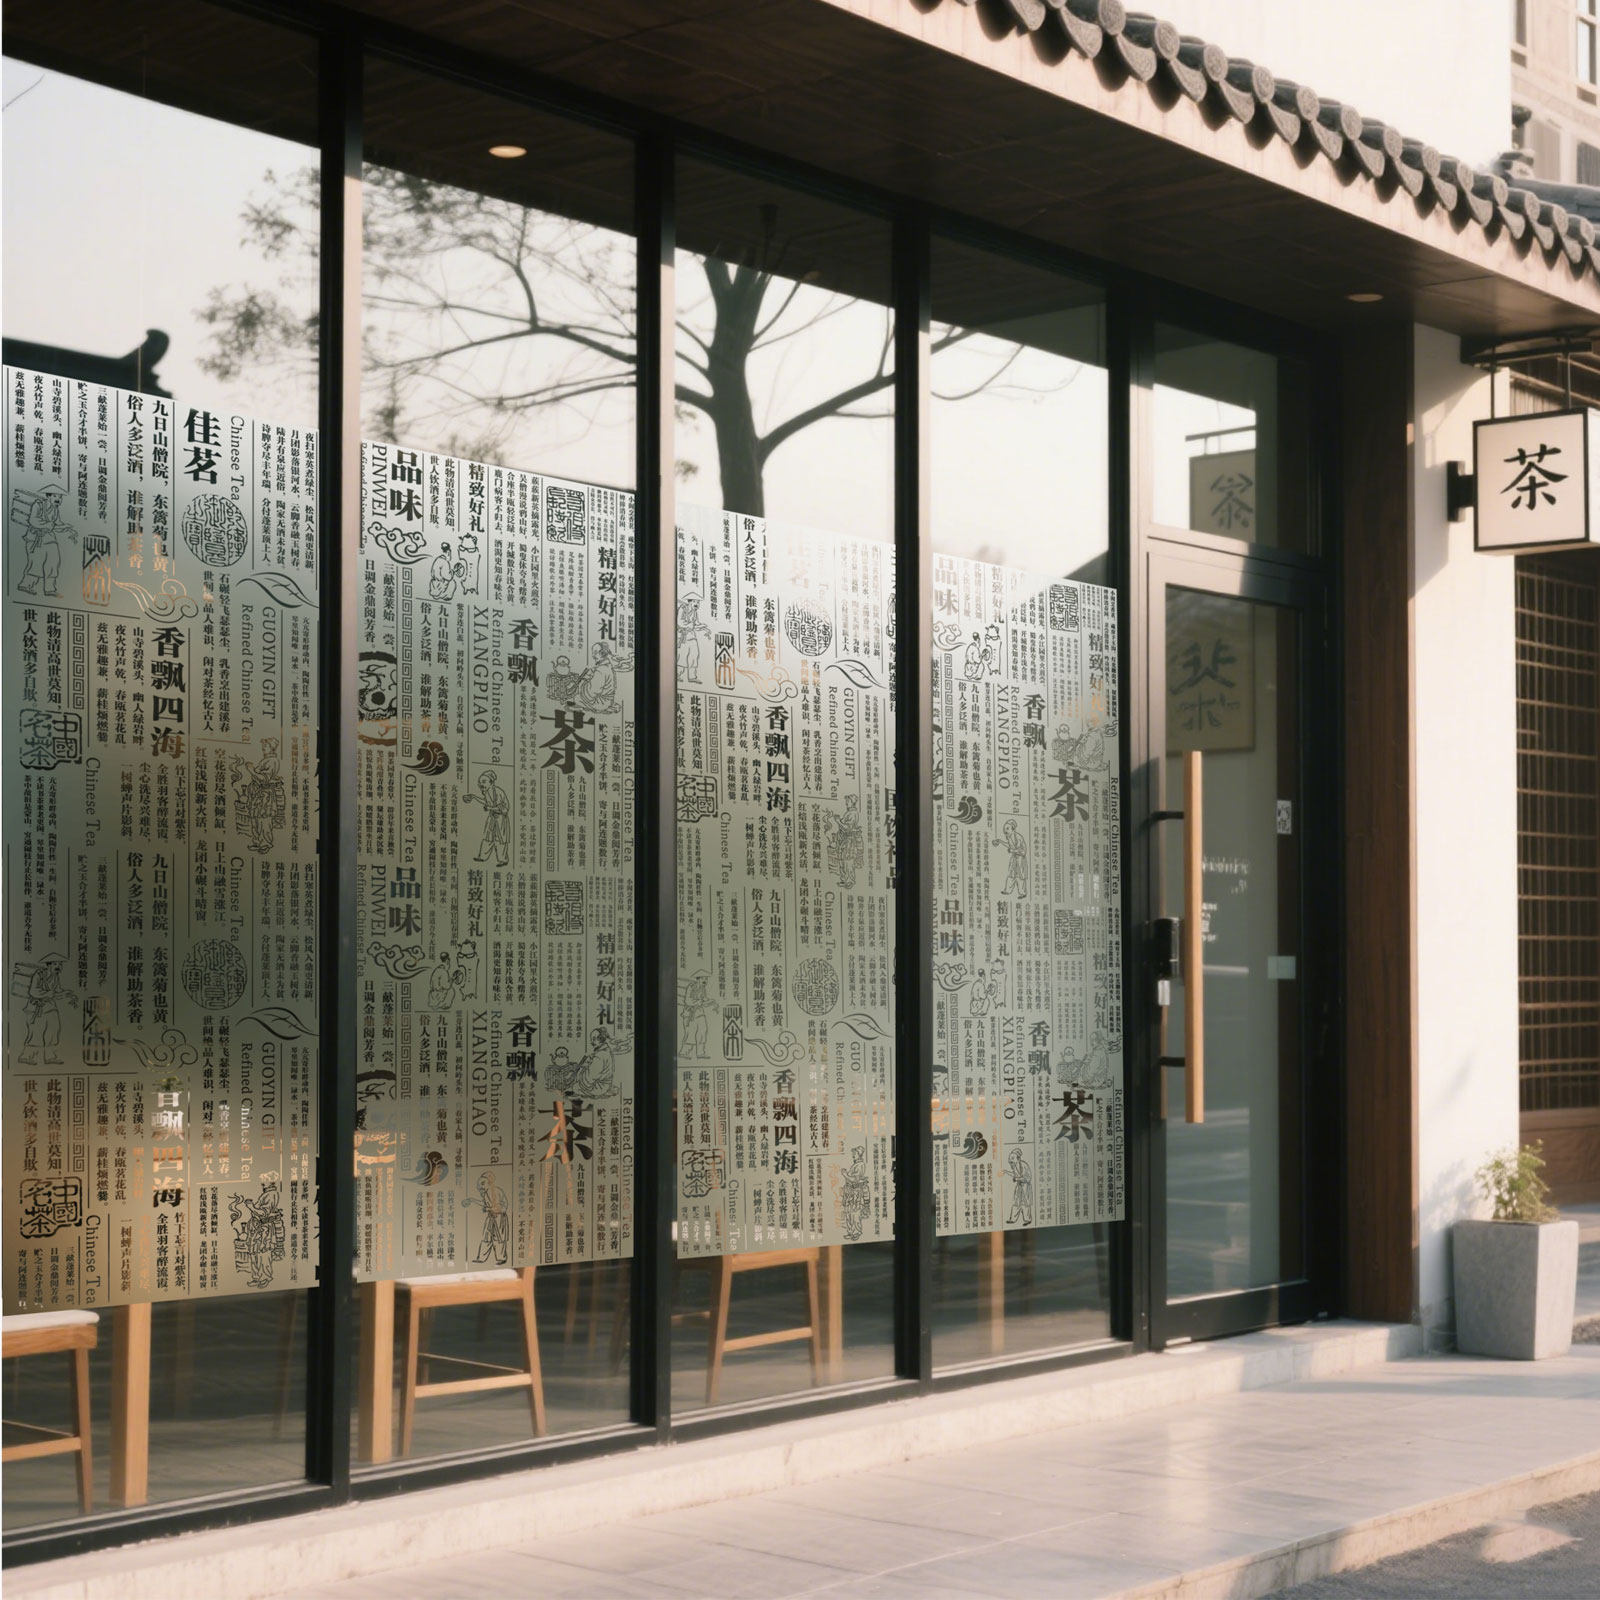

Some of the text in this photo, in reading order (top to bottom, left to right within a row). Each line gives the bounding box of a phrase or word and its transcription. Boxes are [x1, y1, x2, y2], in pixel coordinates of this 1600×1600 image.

[183, 408, 222, 485] 佳茗
[230, 415, 245, 501] Chinese Tea
[372, 443, 387, 519] PINWEI
[1500, 443, 1569, 511] 茶
[390, 450, 424, 522] 品味
[468, 463, 485, 533] 精致好礼
[597, 546, 617, 641] 精致好礼
[241, 604, 254, 743] Refined Chinese Tea
[262, 606, 276, 719] GUOYIN GIFT
[473, 605, 489, 734] XIANGPIAO
[492, 608, 504, 763] Refined Chinese Tea
[507, 618, 540, 687] 香飘
[150, 626, 186, 760] 香飘四海
[1023, 693, 1046, 749] 香飘
[539, 709, 596, 775] 茶
[765, 705, 791, 813] 香飘四海
[829, 686, 840, 800] Refined Chinese Tea
[844, 687, 856, 780] GUOYIN GIFT
[997, 685, 1010, 789] XIANGPIAO
[1011, 686, 1022, 814] Refined Chinese Tea
[85, 757, 100, 847] Chinese Tea
[405, 774, 417, 863] Chinese Tea
[624, 720, 635, 863] Refined Chinese Tea
[1047, 768, 1090, 822] 茶
[1111, 777, 1119, 822] Refined
[721, 812, 733, 884] Chinese Tea
[950, 823, 960, 896] Chinese Tea
[1111, 826, 1120, 871] Chinese
[230, 856, 245, 942] Chinese Tea
[371, 864, 386, 937] PINWEI
[389, 867, 422, 937] 品味
[468, 869, 484, 938] 精致好礼
[940, 900, 963, 956] 品味
[596, 933, 615, 1026] 精致好礼
[241, 1043, 254, 1094] Refined
[261, 1042, 275, 1108] GUOYIN
[472, 1011, 488, 1137] XIANGPIAO
[506, 1015, 538, 1082] 香飘
[1016, 1016, 1027, 1143] Refined Chinese Tea
[1028, 1020, 1051, 1075] 香飘
[490, 1010, 503, 1164] Refined Chinese Tea
[773, 1069, 799, 1175] 香飘四海
[1052, 1089, 1094, 1143] 茶
[537, 1100, 594, 1165] 茶
[623, 1098, 633, 1153] Refined
[241, 1156, 254, 1181] Tea
[86, 1215, 101, 1304] Chinese Tea
